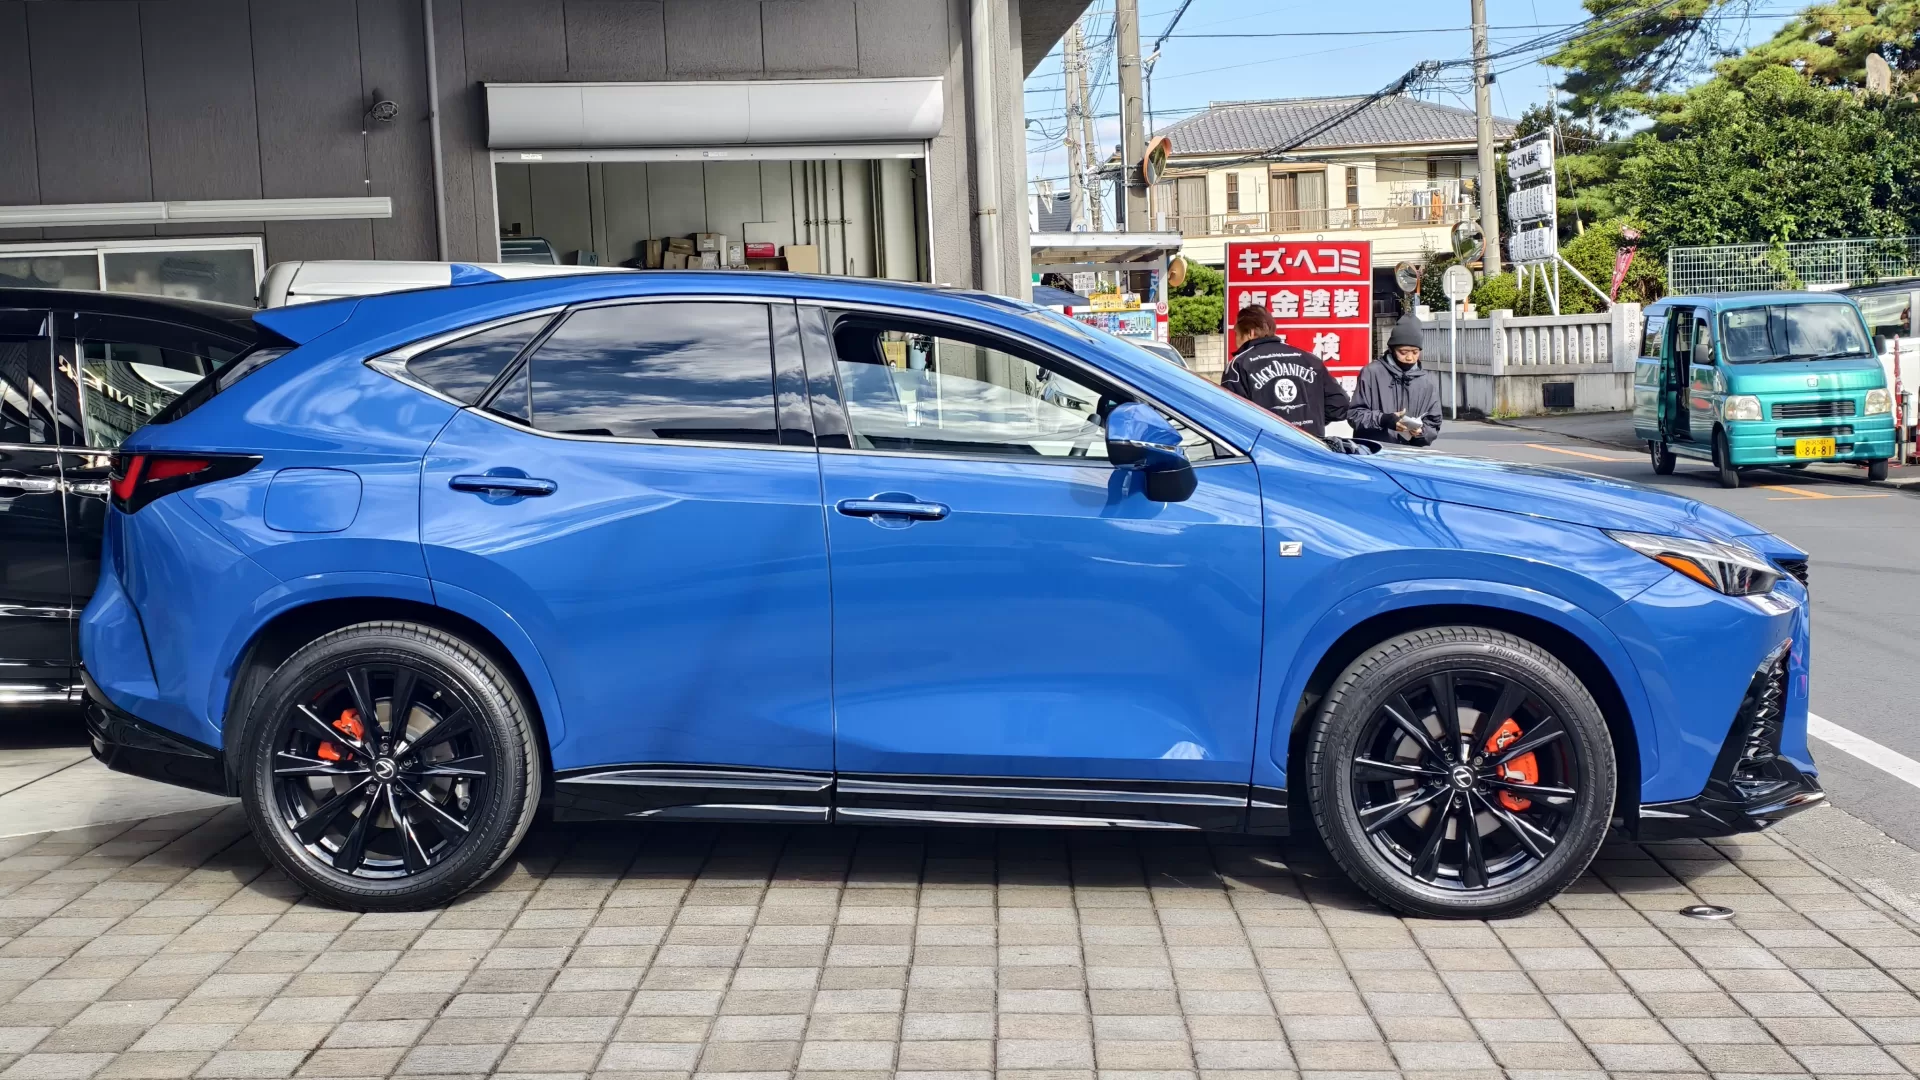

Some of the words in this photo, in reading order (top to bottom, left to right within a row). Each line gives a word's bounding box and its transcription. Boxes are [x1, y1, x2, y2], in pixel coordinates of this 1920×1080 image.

[1238, 248, 1361, 275] キズ・ヘコミ
[1250, 364, 1278, 390] JACK
[1805, 445, 1832, 456] 84-81
[1488, 645, 1552, 677] BRIDGESTONE
